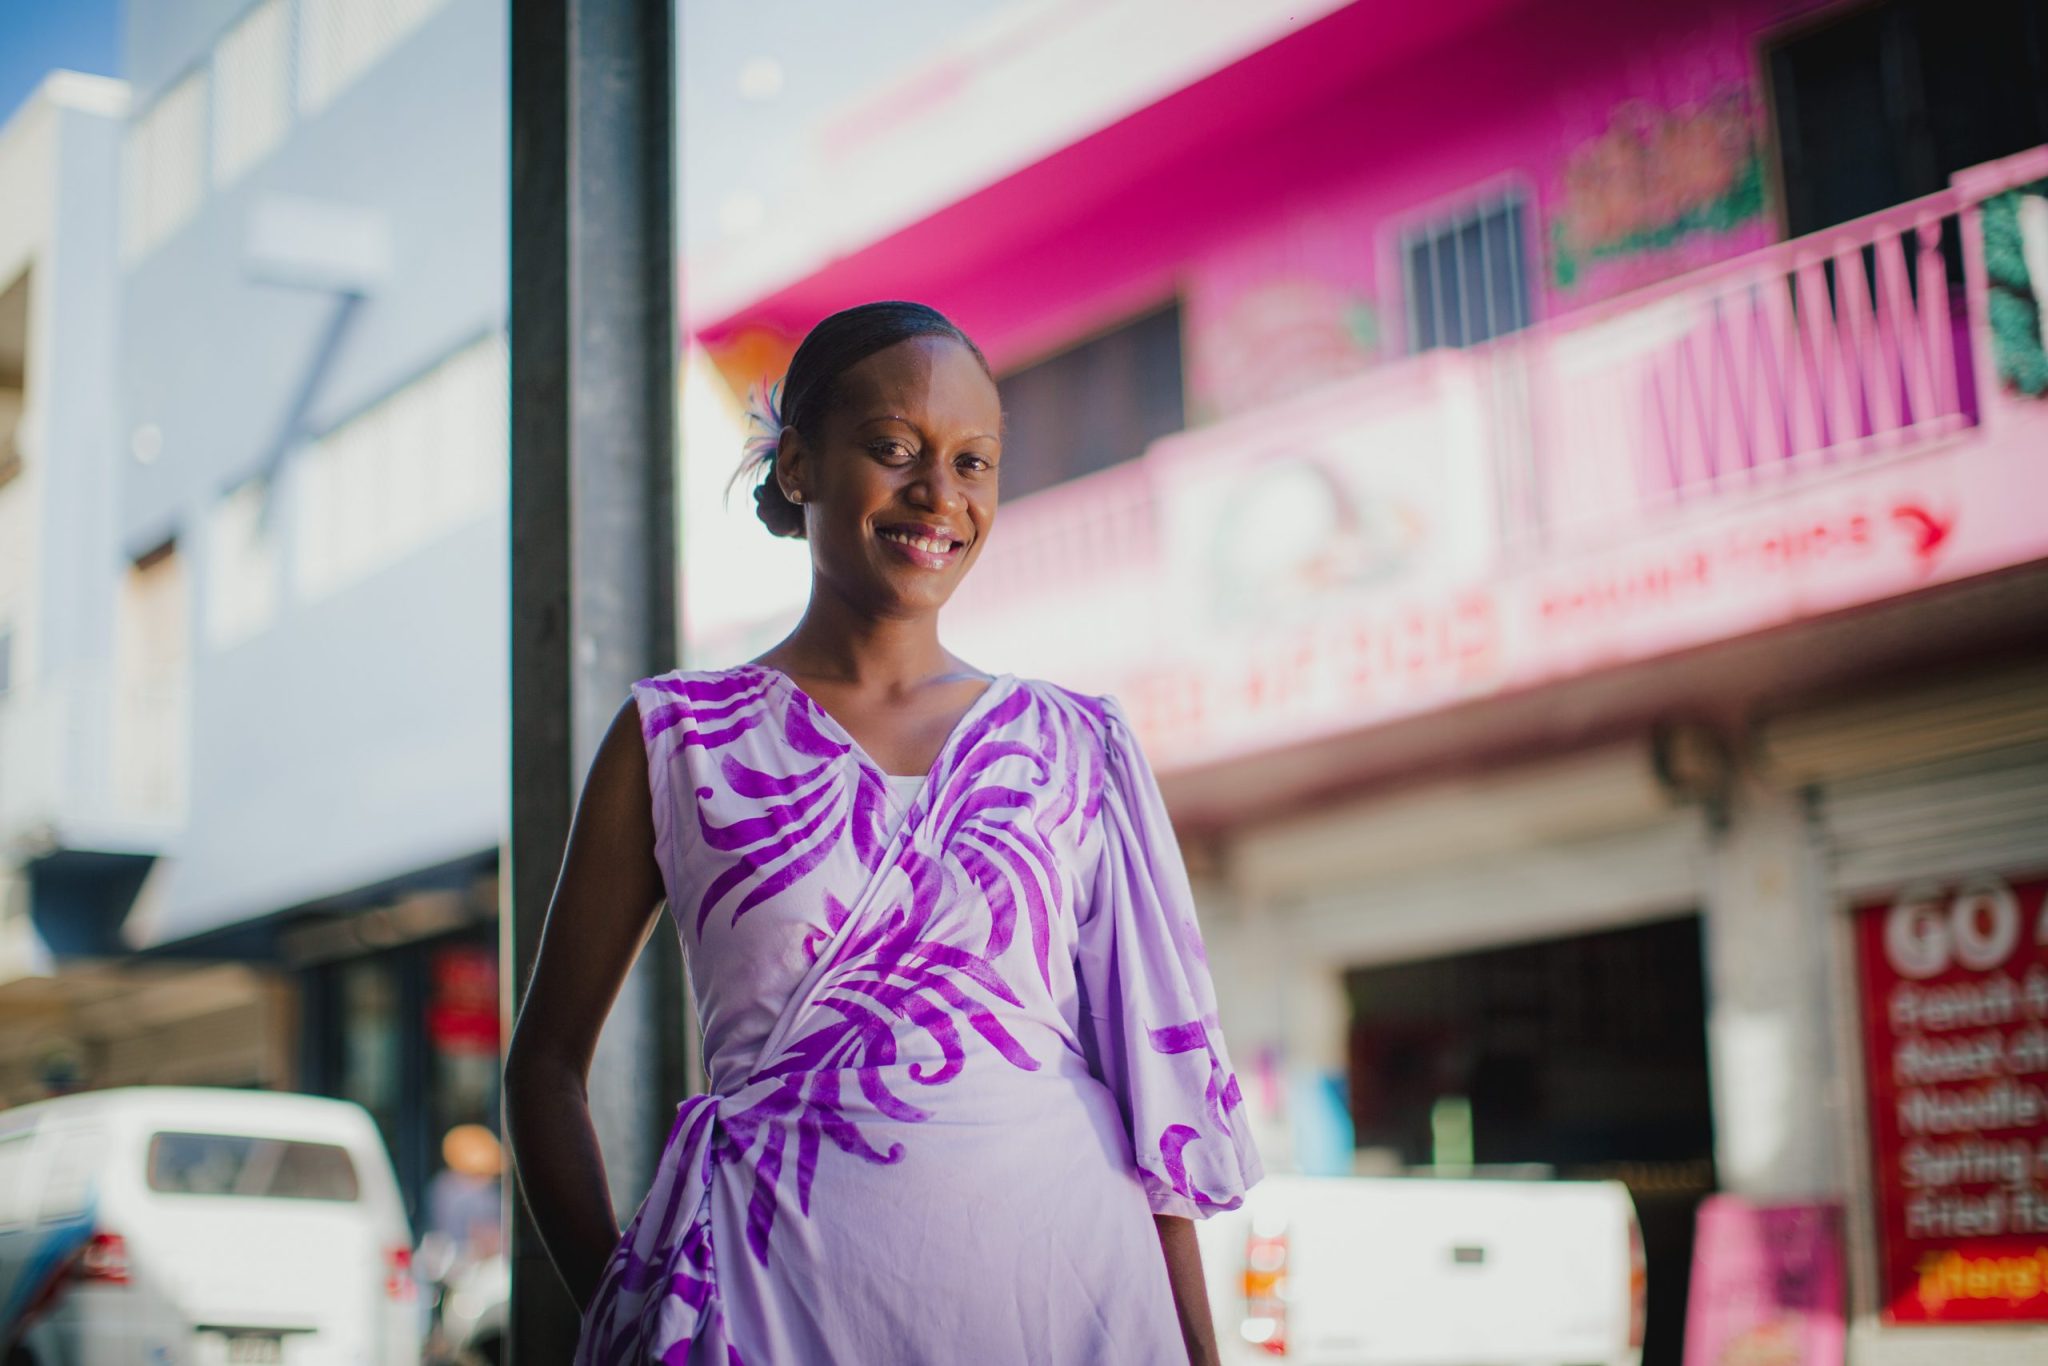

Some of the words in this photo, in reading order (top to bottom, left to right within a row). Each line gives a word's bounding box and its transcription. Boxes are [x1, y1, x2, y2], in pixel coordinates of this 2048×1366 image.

[1884, 884, 2020, 977] GO
[1888, 974, 2016, 1035] French
[1897, 1080, 2044, 1137] Noodle
[1902, 1137, 2033, 1190] Spring
